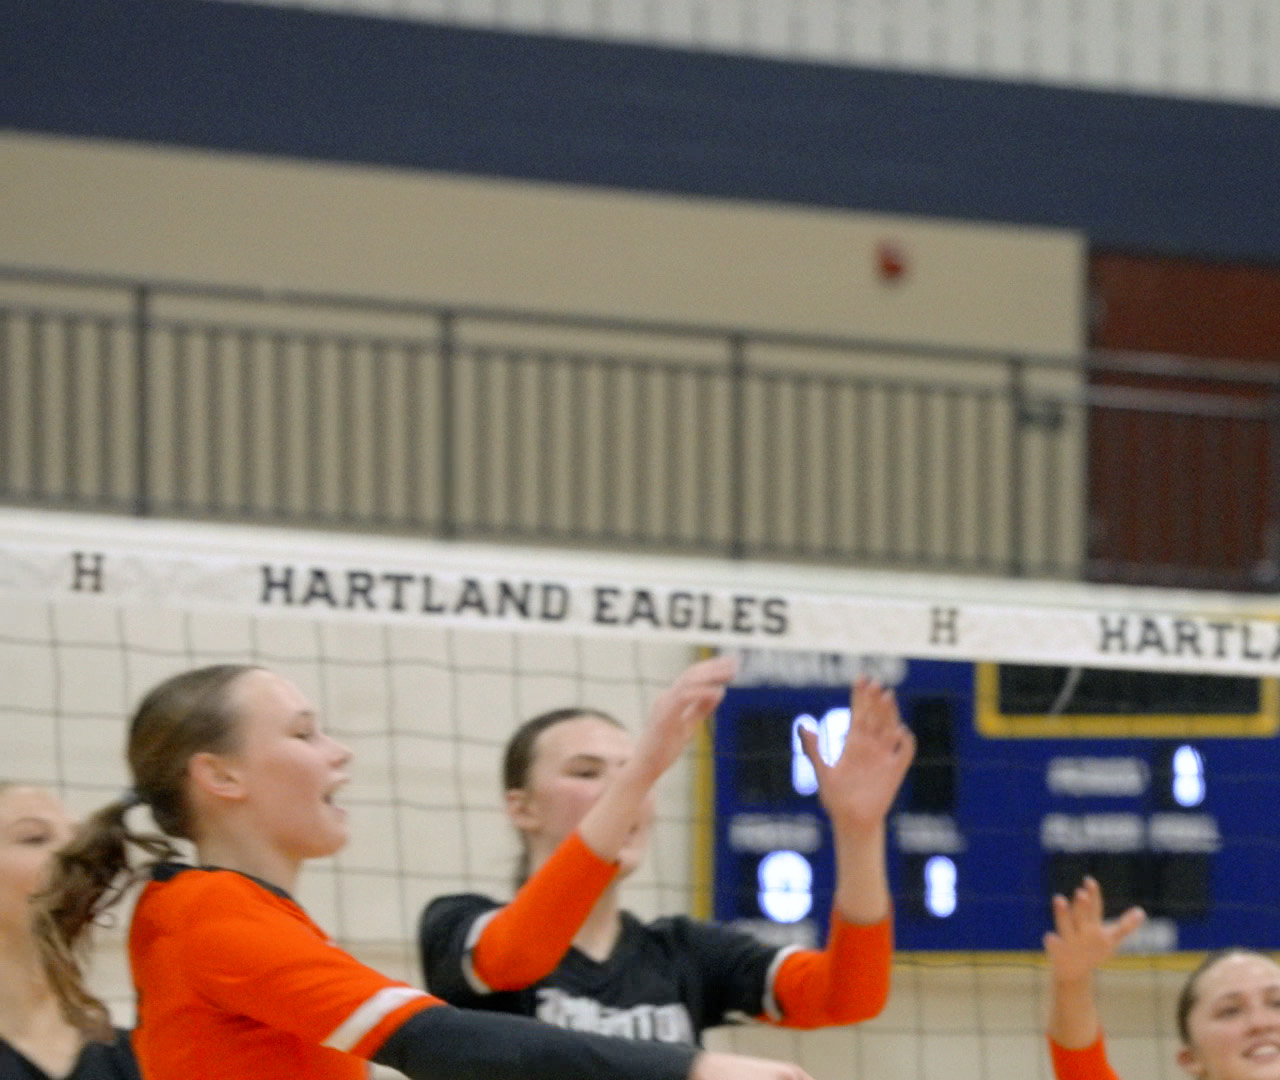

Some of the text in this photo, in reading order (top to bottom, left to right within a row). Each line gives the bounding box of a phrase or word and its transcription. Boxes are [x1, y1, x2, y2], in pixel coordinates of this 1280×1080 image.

[72, 552, 105, 593] H
[260, 564, 788, 636] HARTLAND EAGLES
[930, 607, 958, 645] H
